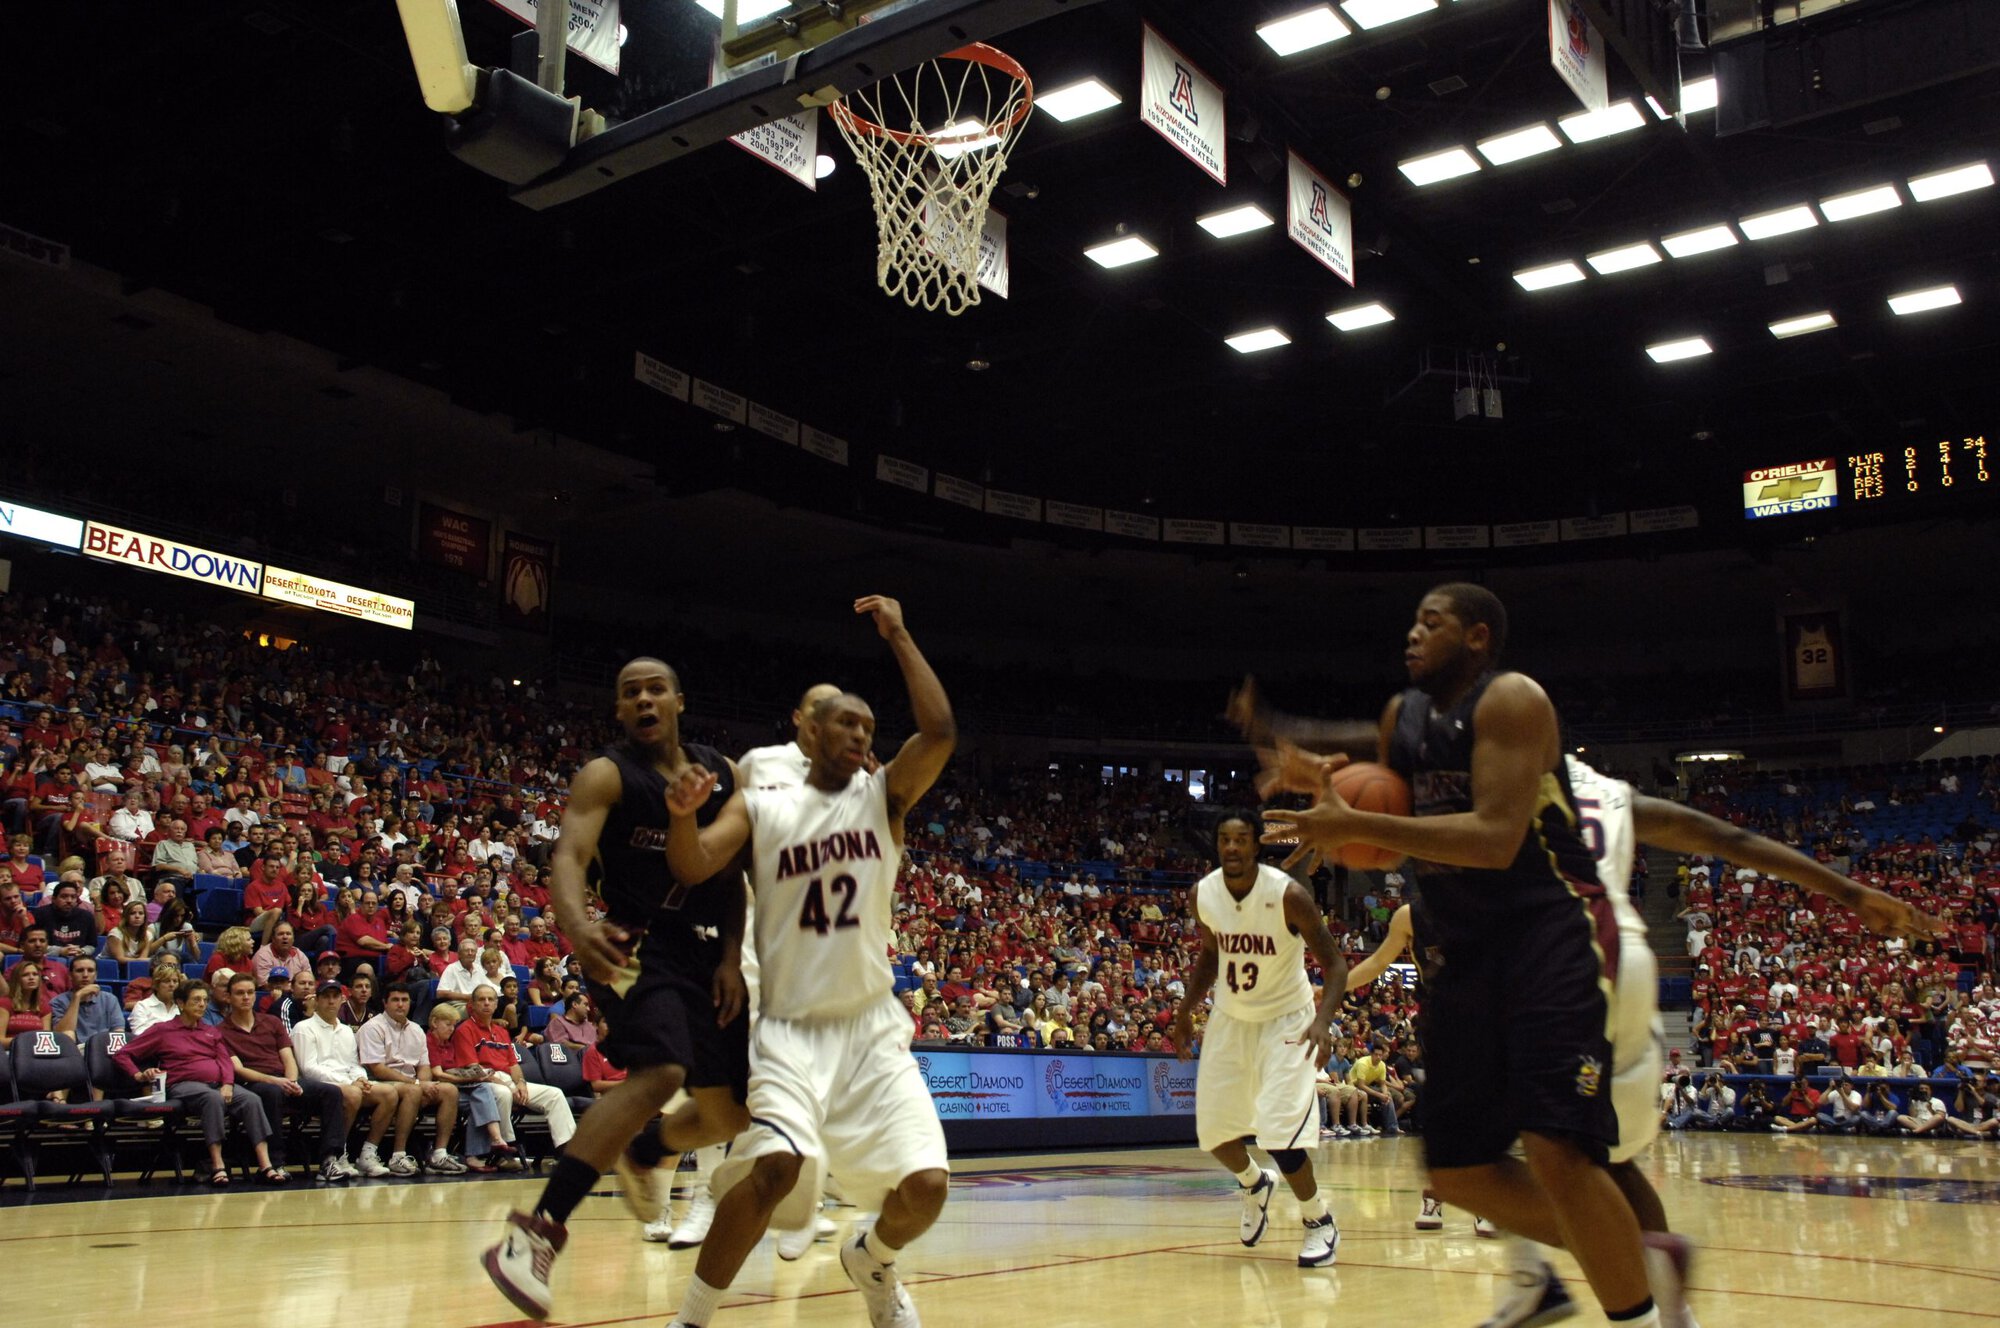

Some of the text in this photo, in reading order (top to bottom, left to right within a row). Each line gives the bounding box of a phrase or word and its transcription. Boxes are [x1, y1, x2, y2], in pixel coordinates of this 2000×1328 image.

[1170, 62, 1198, 126] A
[750, 138, 770, 155] 2000
[765, 137, 784, 152] 1997
[1147, 108, 1219, 172] 1991 SWEET SIXTEEN
[1310, 181, 1332, 236] A
[1307, 237, 1325, 256] SWEET
[1326, 252, 1349, 275] SIXTEEN
[1904, 447, 1915, 458] 0
[1939, 441, 1950, 453] 5
[1963, 436, 1986, 450] 34
[1750, 460, 1827, 481] O'RIELLY
[1855, 464, 1881, 477] PTS
[1905, 459, 1916, 469] 2
[1940, 453, 1951, 464] 4
[1854, 475, 1883, 489] RBS
[1907, 480, 1918, 492] 0
[1942, 475, 1952, 486] 0
[1977, 470, 1988, 481] 0
[1753, 497, 1831, 518] WATSON
[442, 516, 469, 532] WAC
[265, 575, 336, 599] DESERT TOYOTA
[346, 595, 413, 618] DESERT TOYOTA
[1802, 649, 1827, 664] 32
[776, 830, 881, 883] ARIZONA
[800, 874, 860, 936] 42
[1227, 961, 1260, 994] 43
[997, 1035, 1018, 1047] POSS.
[969, 1072, 1025, 1090] DIAMOND
[1054, 1073, 1143, 1090] DESERT DIAMOND
[1160, 1074, 1196, 1090] DESERT
[940, 1102, 1011, 1113] CASINO HOTEL
[1071, 1101, 1132, 1112] CASINO HOTEL
